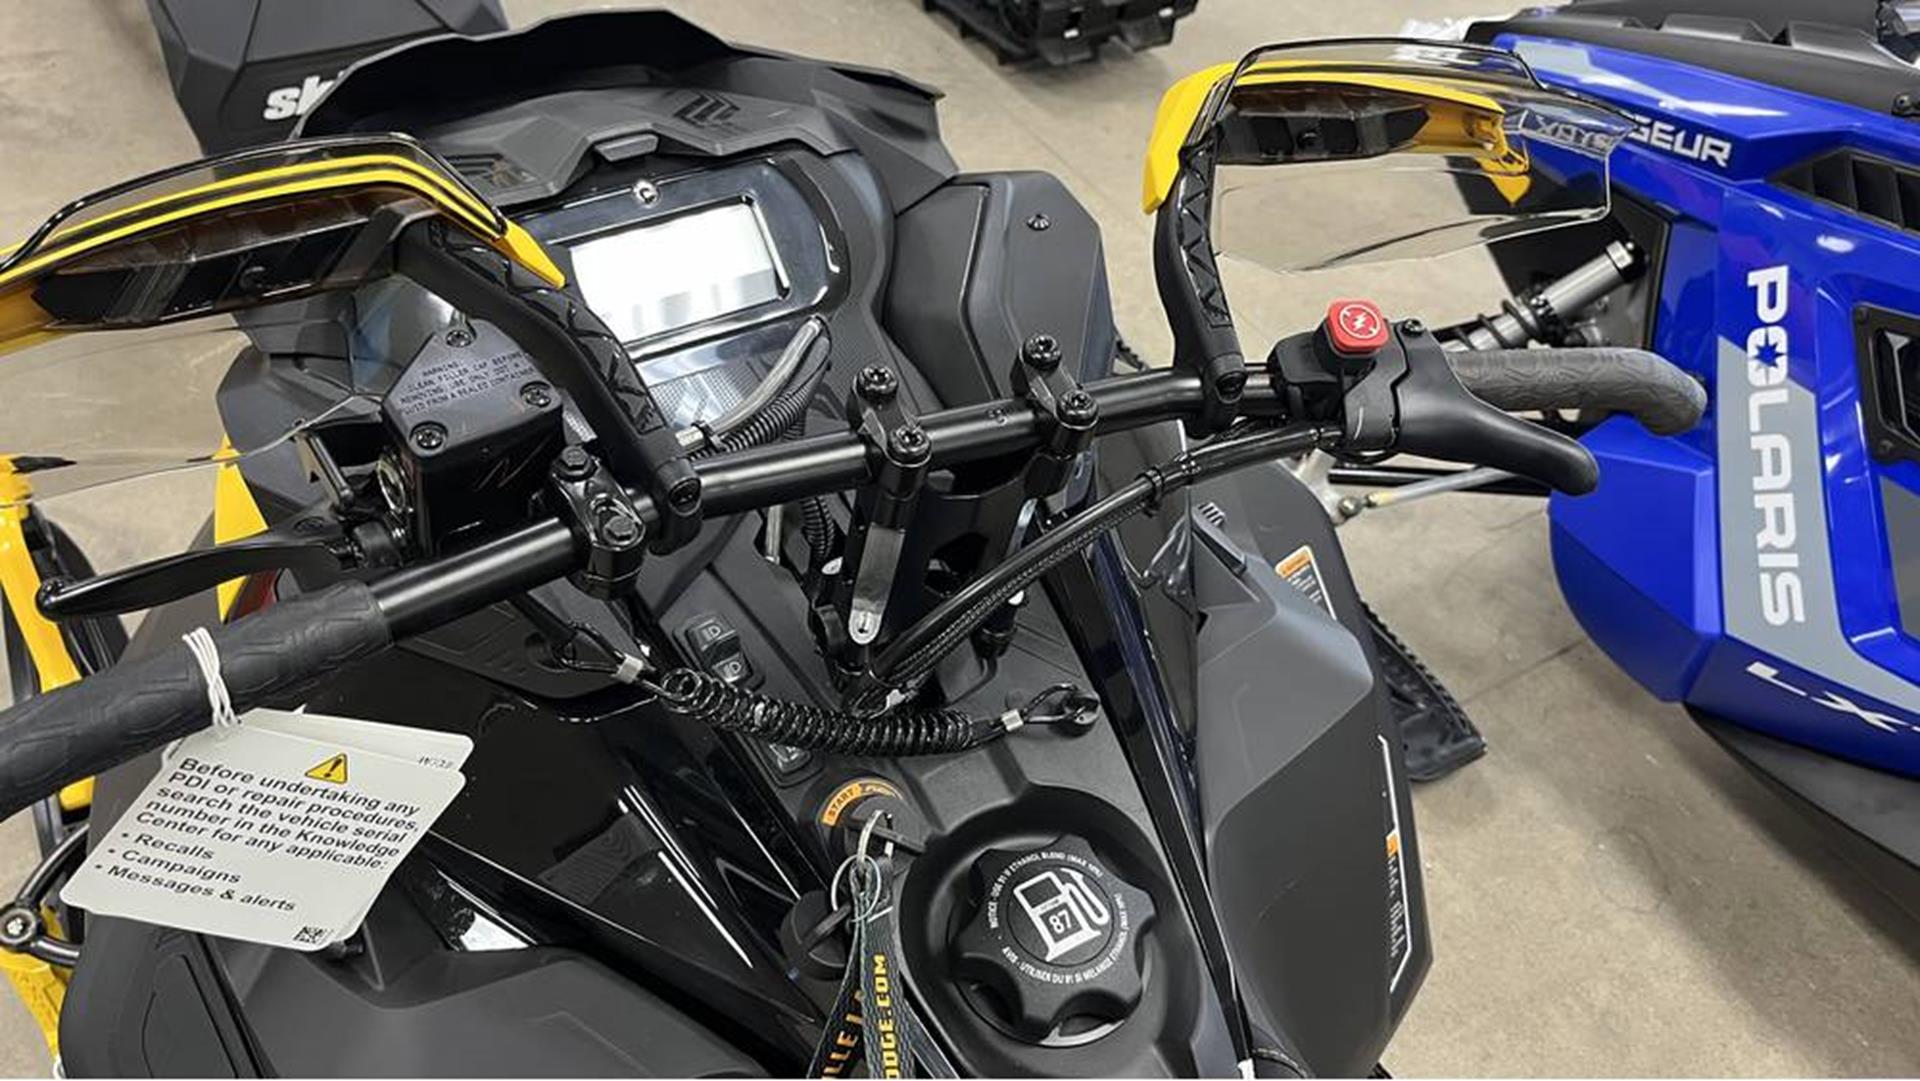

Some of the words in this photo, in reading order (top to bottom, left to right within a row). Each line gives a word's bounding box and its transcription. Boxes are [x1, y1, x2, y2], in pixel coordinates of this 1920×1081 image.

[264, 75, 340, 120] sk
[1746, 265, 1805, 627] POLARIS
[156, 787, 232, 811] search
[238, 803, 272, 819] the
[279, 812, 348, 834] vehicle
[352, 826, 407, 843] serial
[169, 771, 210, 790] PDI
[214, 784, 239, 796] or
[242, 790, 305, 809] repair
[306, 803, 419, 832] procedures,
[179, 757, 254, 783] Before
[260, 777, 380, 811] undertaking
[384, 801, 420, 818] any
[134, 833, 215, 860] Recalls
[136, 811, 208, 835] Center
[211, 828, 243, 842] for
[244, 837, 283, 853] any
[286, 845, 388, 870] applicable:
[145, 801, 231, 825] number
[234, 817, 254, 830] in
[258, 823, 291, 838] the
[295, 829, 399, 857] Knowledge
[107, 865, 214, 897] Messages
[220, 889, 236, 901] &
[240, 893, 297, 911] alerts
[121, 850, 241, 884] Campaigns
[1048, 909, 1072, 934] 87
